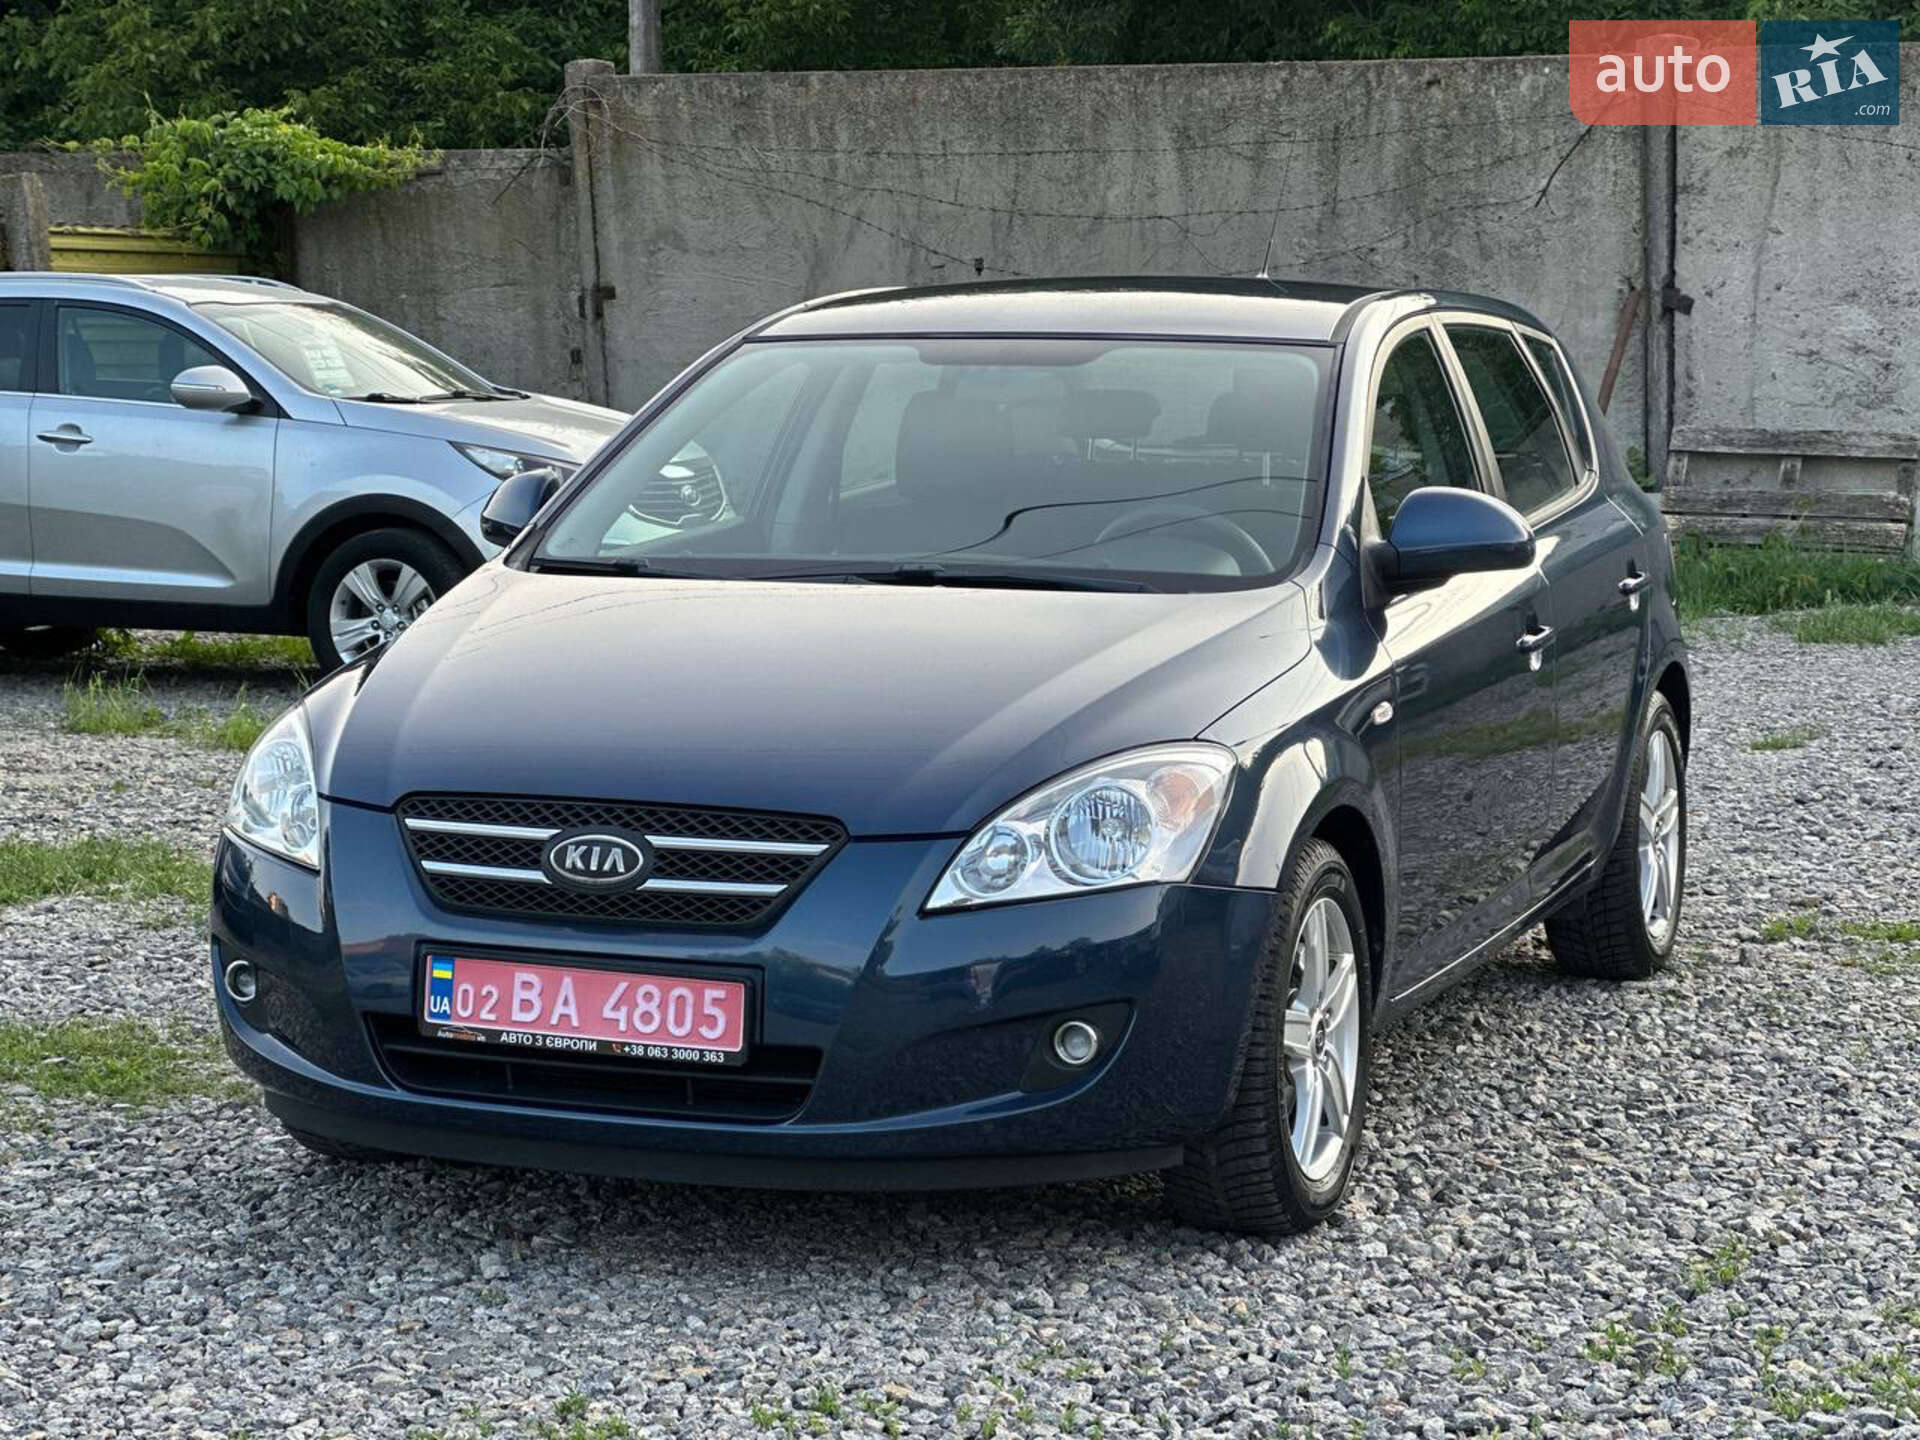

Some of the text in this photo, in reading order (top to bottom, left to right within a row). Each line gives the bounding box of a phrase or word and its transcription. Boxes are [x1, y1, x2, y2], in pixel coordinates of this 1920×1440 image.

[565, 845, 625, 873] KIA
[430, 995, 451, 1015] UA
[456, 983, 499, 1021] 02
[602, 981, 727, 1040] 4805
[500, 1031, 533, 1045] АВТО
[545, 1036, 598, 1052] ЄВРОПИ
[623, 1045, 725, 1063] +38 063 3000 363
